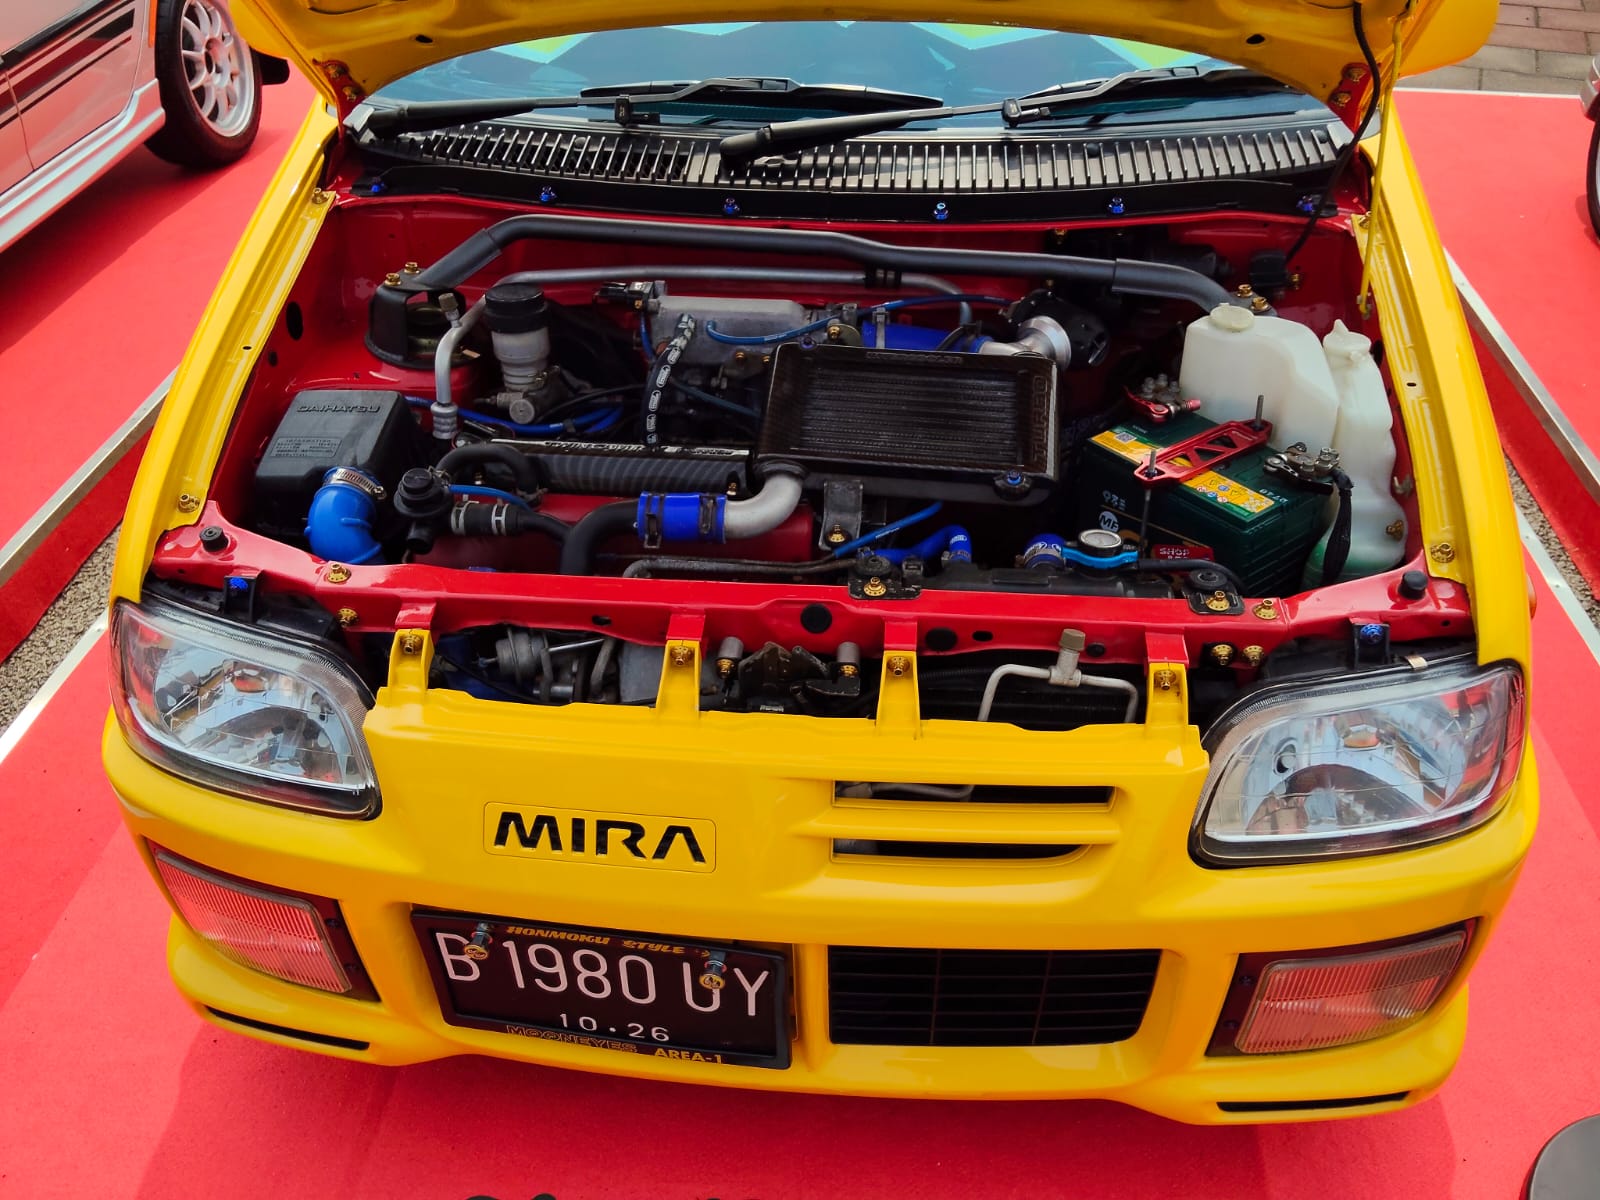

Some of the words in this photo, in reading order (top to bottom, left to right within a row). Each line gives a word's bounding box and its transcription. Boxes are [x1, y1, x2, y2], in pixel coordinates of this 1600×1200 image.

[296, 404, 381, 413] DAIHATSU
[1031, 375, 1049, 463] TURBO
[1099, 514, 1120, 531] MF
[1159, 546, 1190, 556] SHOP
[494, 811, 707, 863] MIRA
[506, 925, 610, 945] HONMOKU
[622, 939, 686, 955] STYLE
[435, 932, 481, 982] B
[501, 940, 657, 1006] 1980
[682, 961, 770, 1017] UY
[506, 1024, 638, 1055] MOONEYES
[653, 1046, 725, 1065] AREA-1
